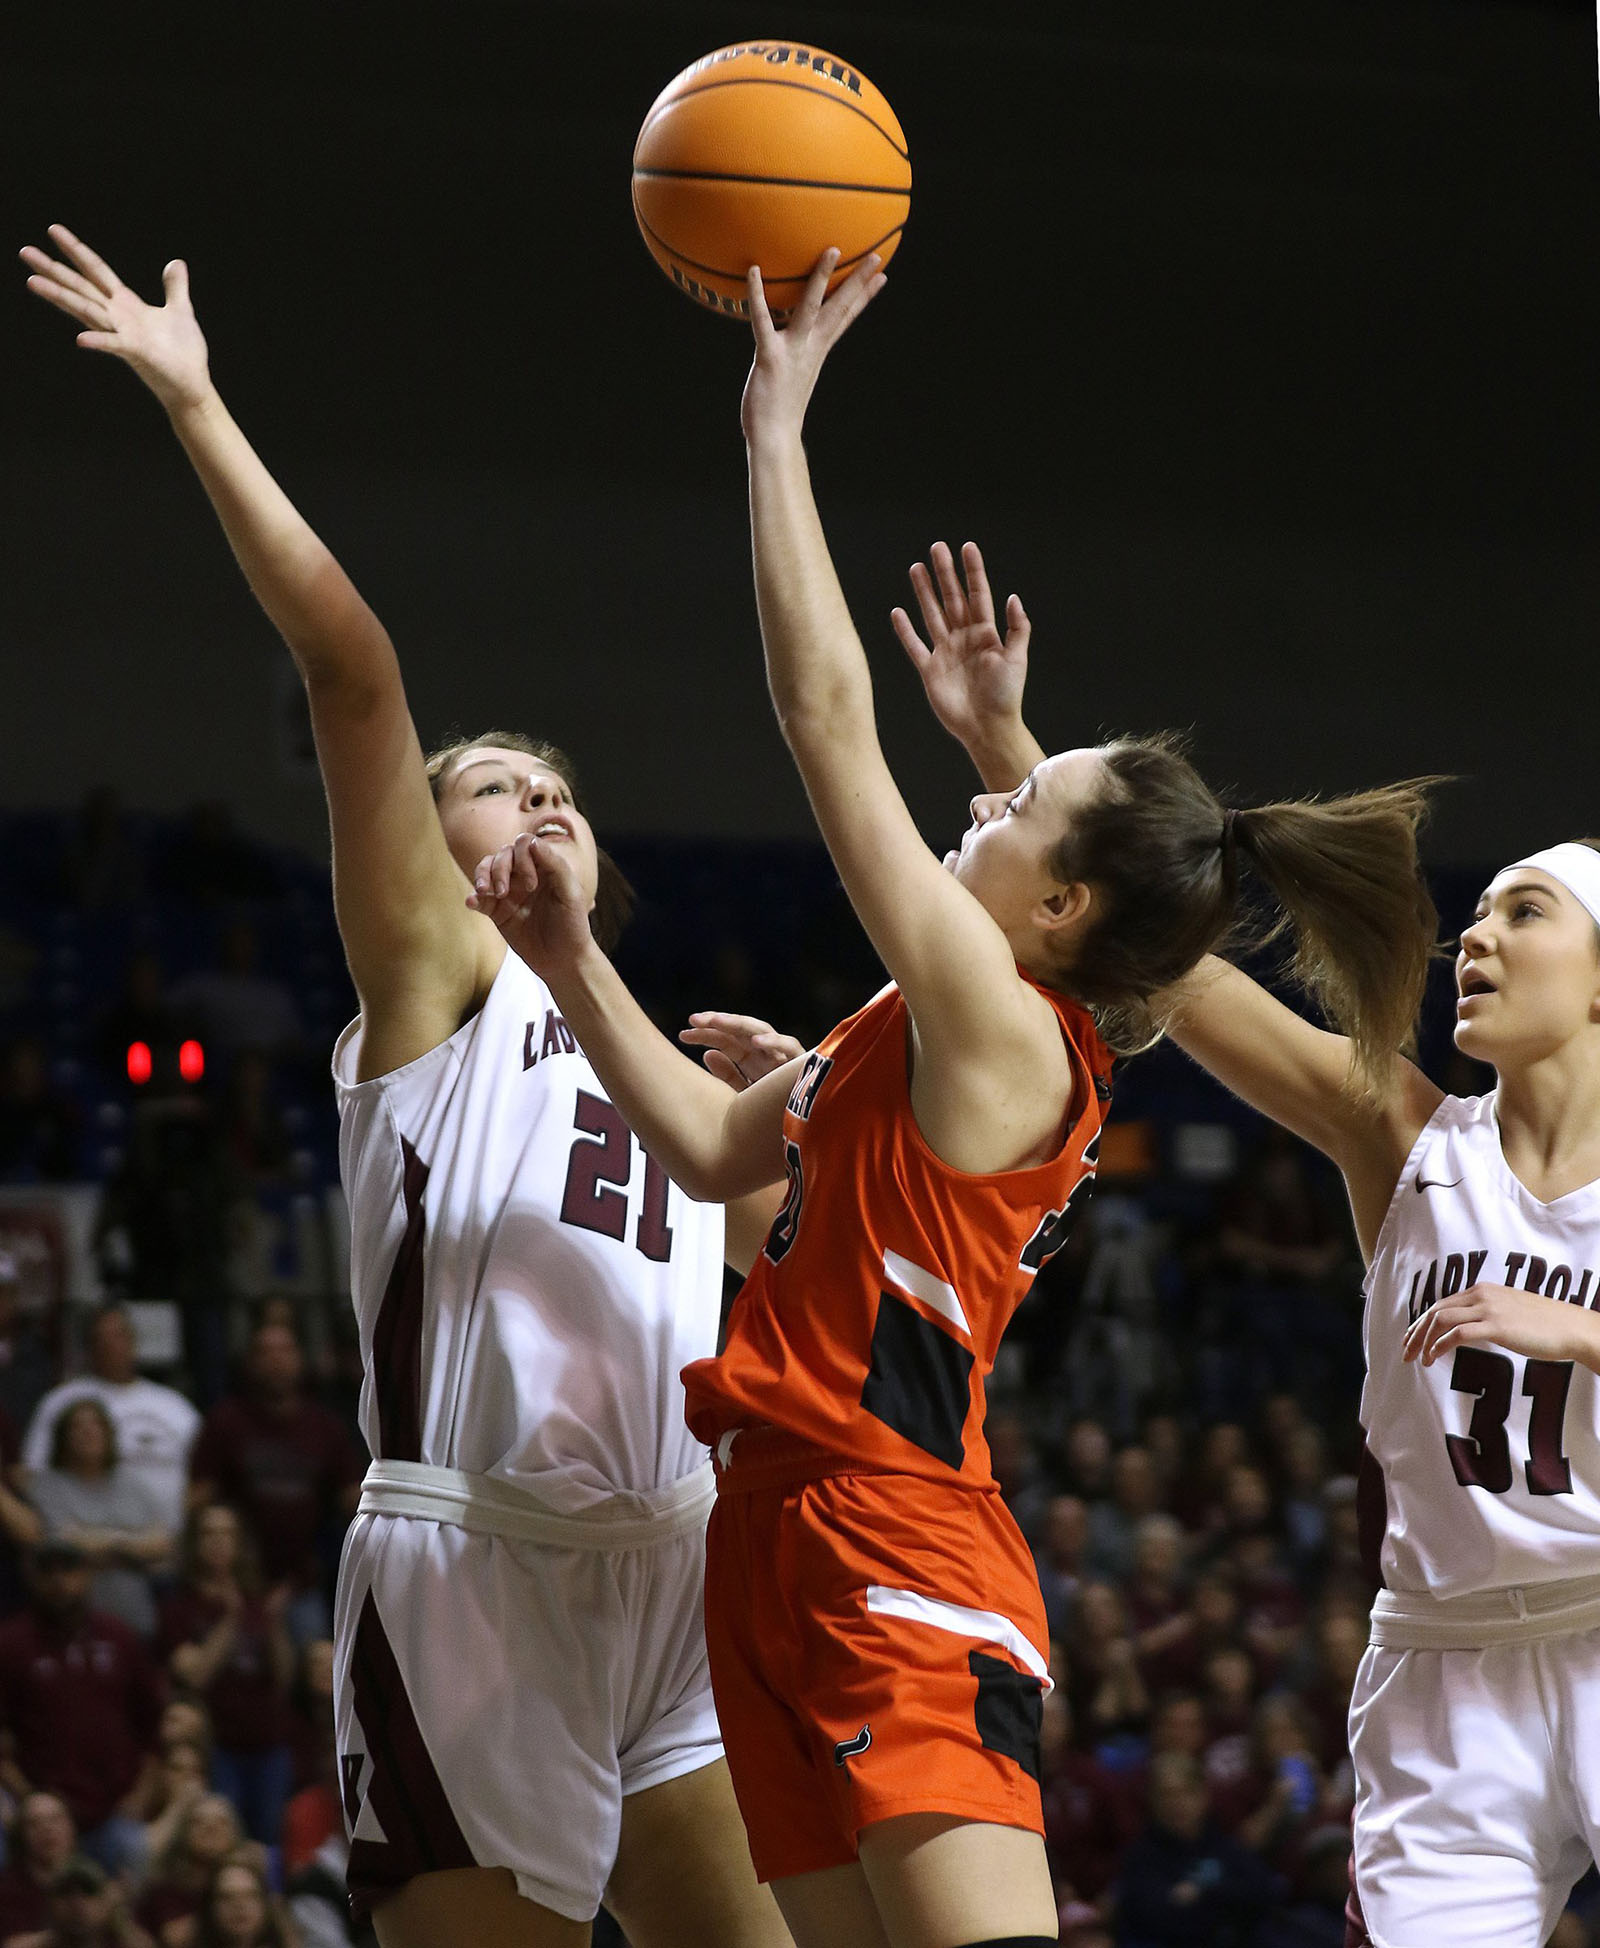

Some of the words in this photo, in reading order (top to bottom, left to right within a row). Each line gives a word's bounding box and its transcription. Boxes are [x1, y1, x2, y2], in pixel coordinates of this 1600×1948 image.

[522, 1008, 577, 1072] LAD
[559, 1087, 673, 1263] 21
[1408, 1250, 1488, 1328] LADY
[1504, 1251, 1600, 1313] TROJ
[1445, 1346, 1574, 1496] 31
